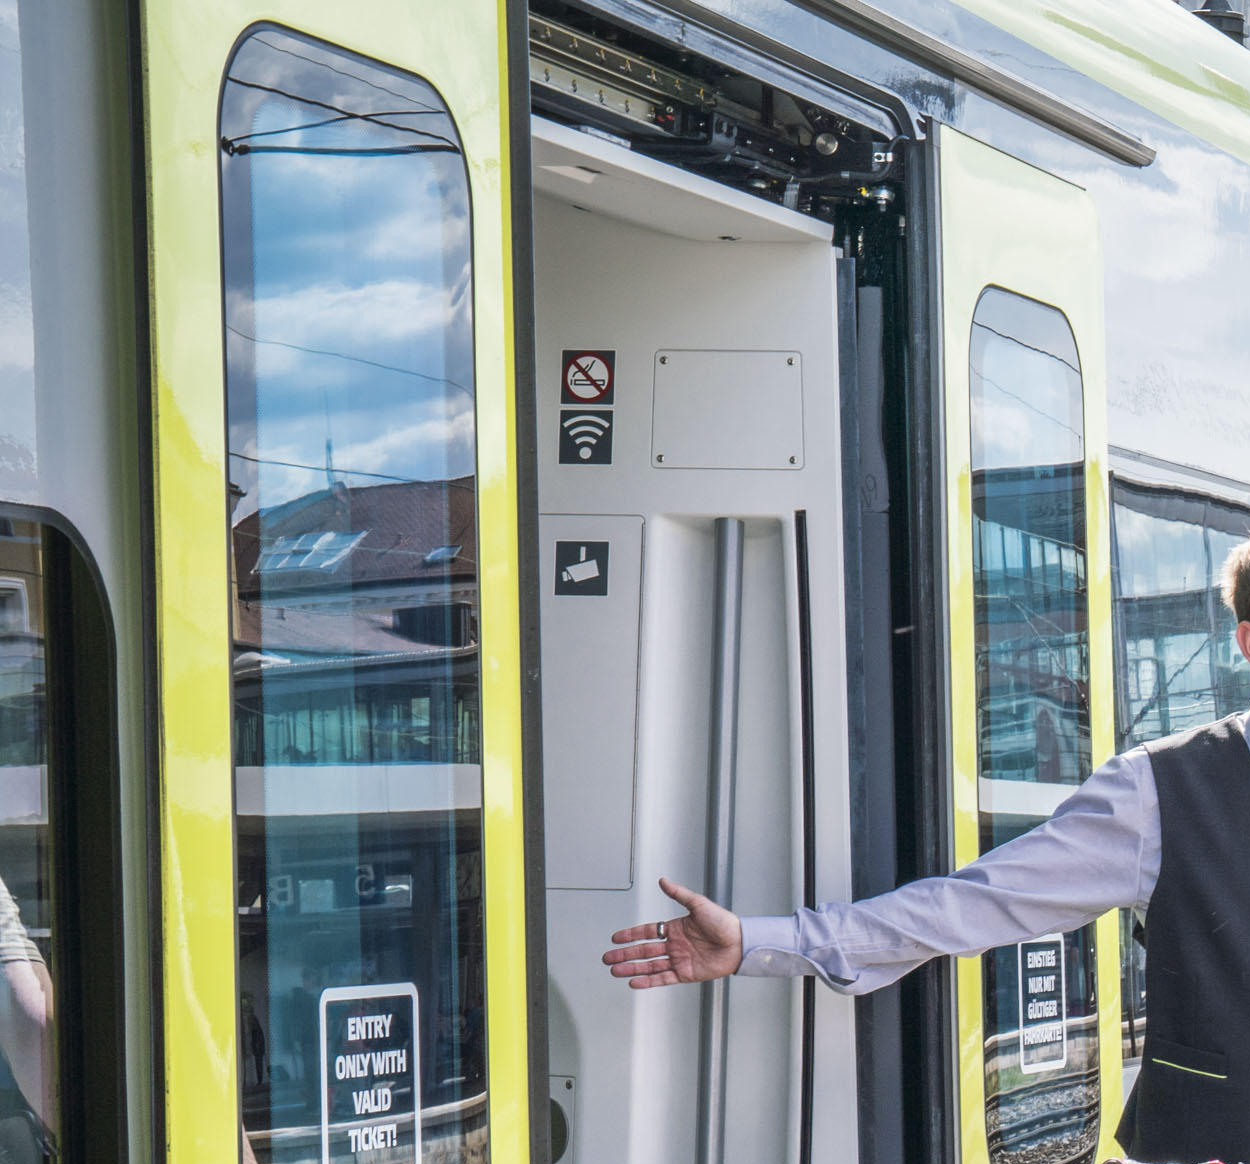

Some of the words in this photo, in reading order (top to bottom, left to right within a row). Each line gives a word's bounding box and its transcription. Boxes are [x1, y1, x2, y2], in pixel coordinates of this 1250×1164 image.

[1027, 950, 1056, 969] EINSTIEG
[1028, 976, 1043, 994] NUR
[1043, 975, 1056, 992] MIT
[1028, 999, 1058, 1020] GÜLTIGER
[347, 1014, 393, 1041] ENTRY
[335, 1055, 371, 1080] ONLY
[371, 1049, 407, 1076] WITH
[352, 1087, 392, 1115] VALID
[348, 1123, 397, 1152] TICKET!
